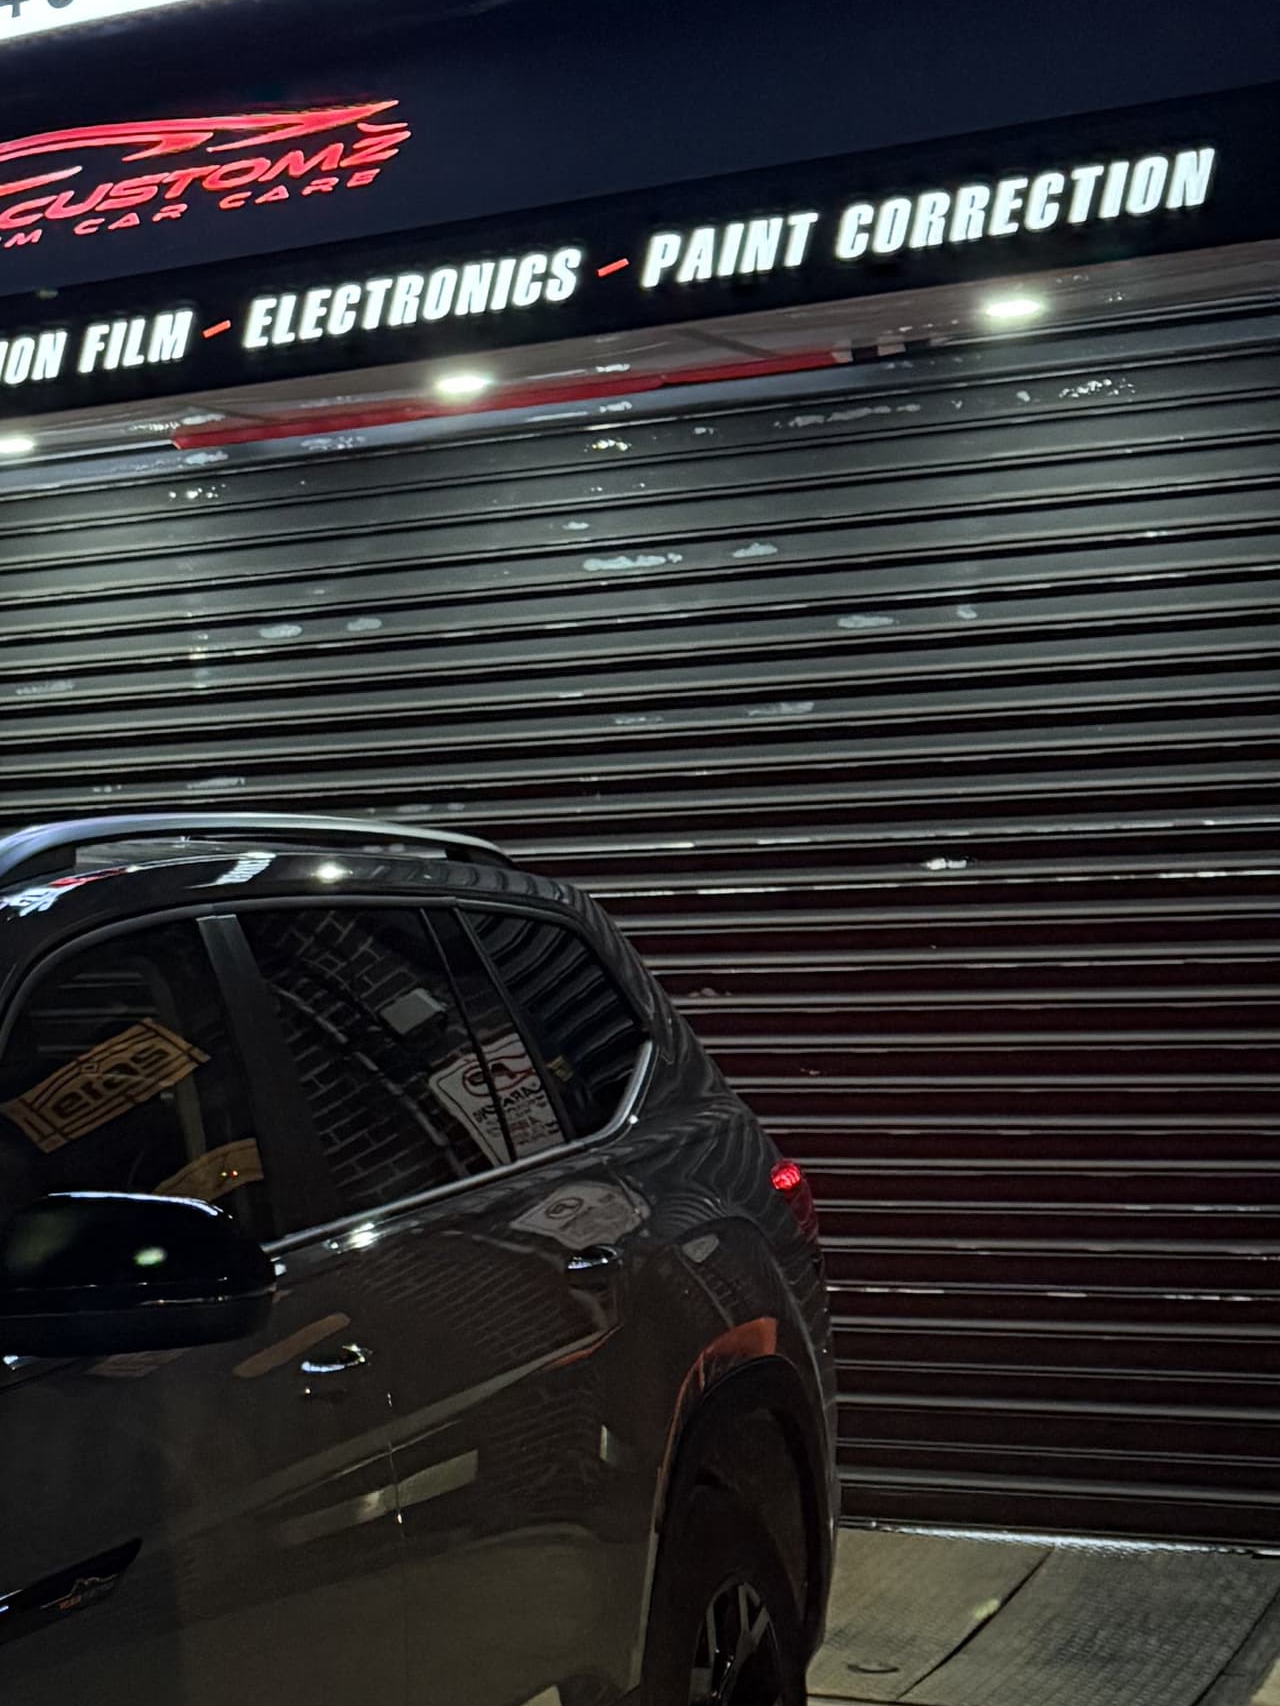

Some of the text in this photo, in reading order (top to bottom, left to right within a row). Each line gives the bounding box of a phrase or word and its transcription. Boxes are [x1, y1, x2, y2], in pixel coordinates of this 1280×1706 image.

[73, 201, 192, 239] CAR
[217, 166, 383, 212] CARE
[77, 309, 195, 372] FILM
[240, 245, 585, 352] ELECTRONICS
[638, 208, 822, 292] PAINT
[834, 146, 1219, 264] CORRECTION
